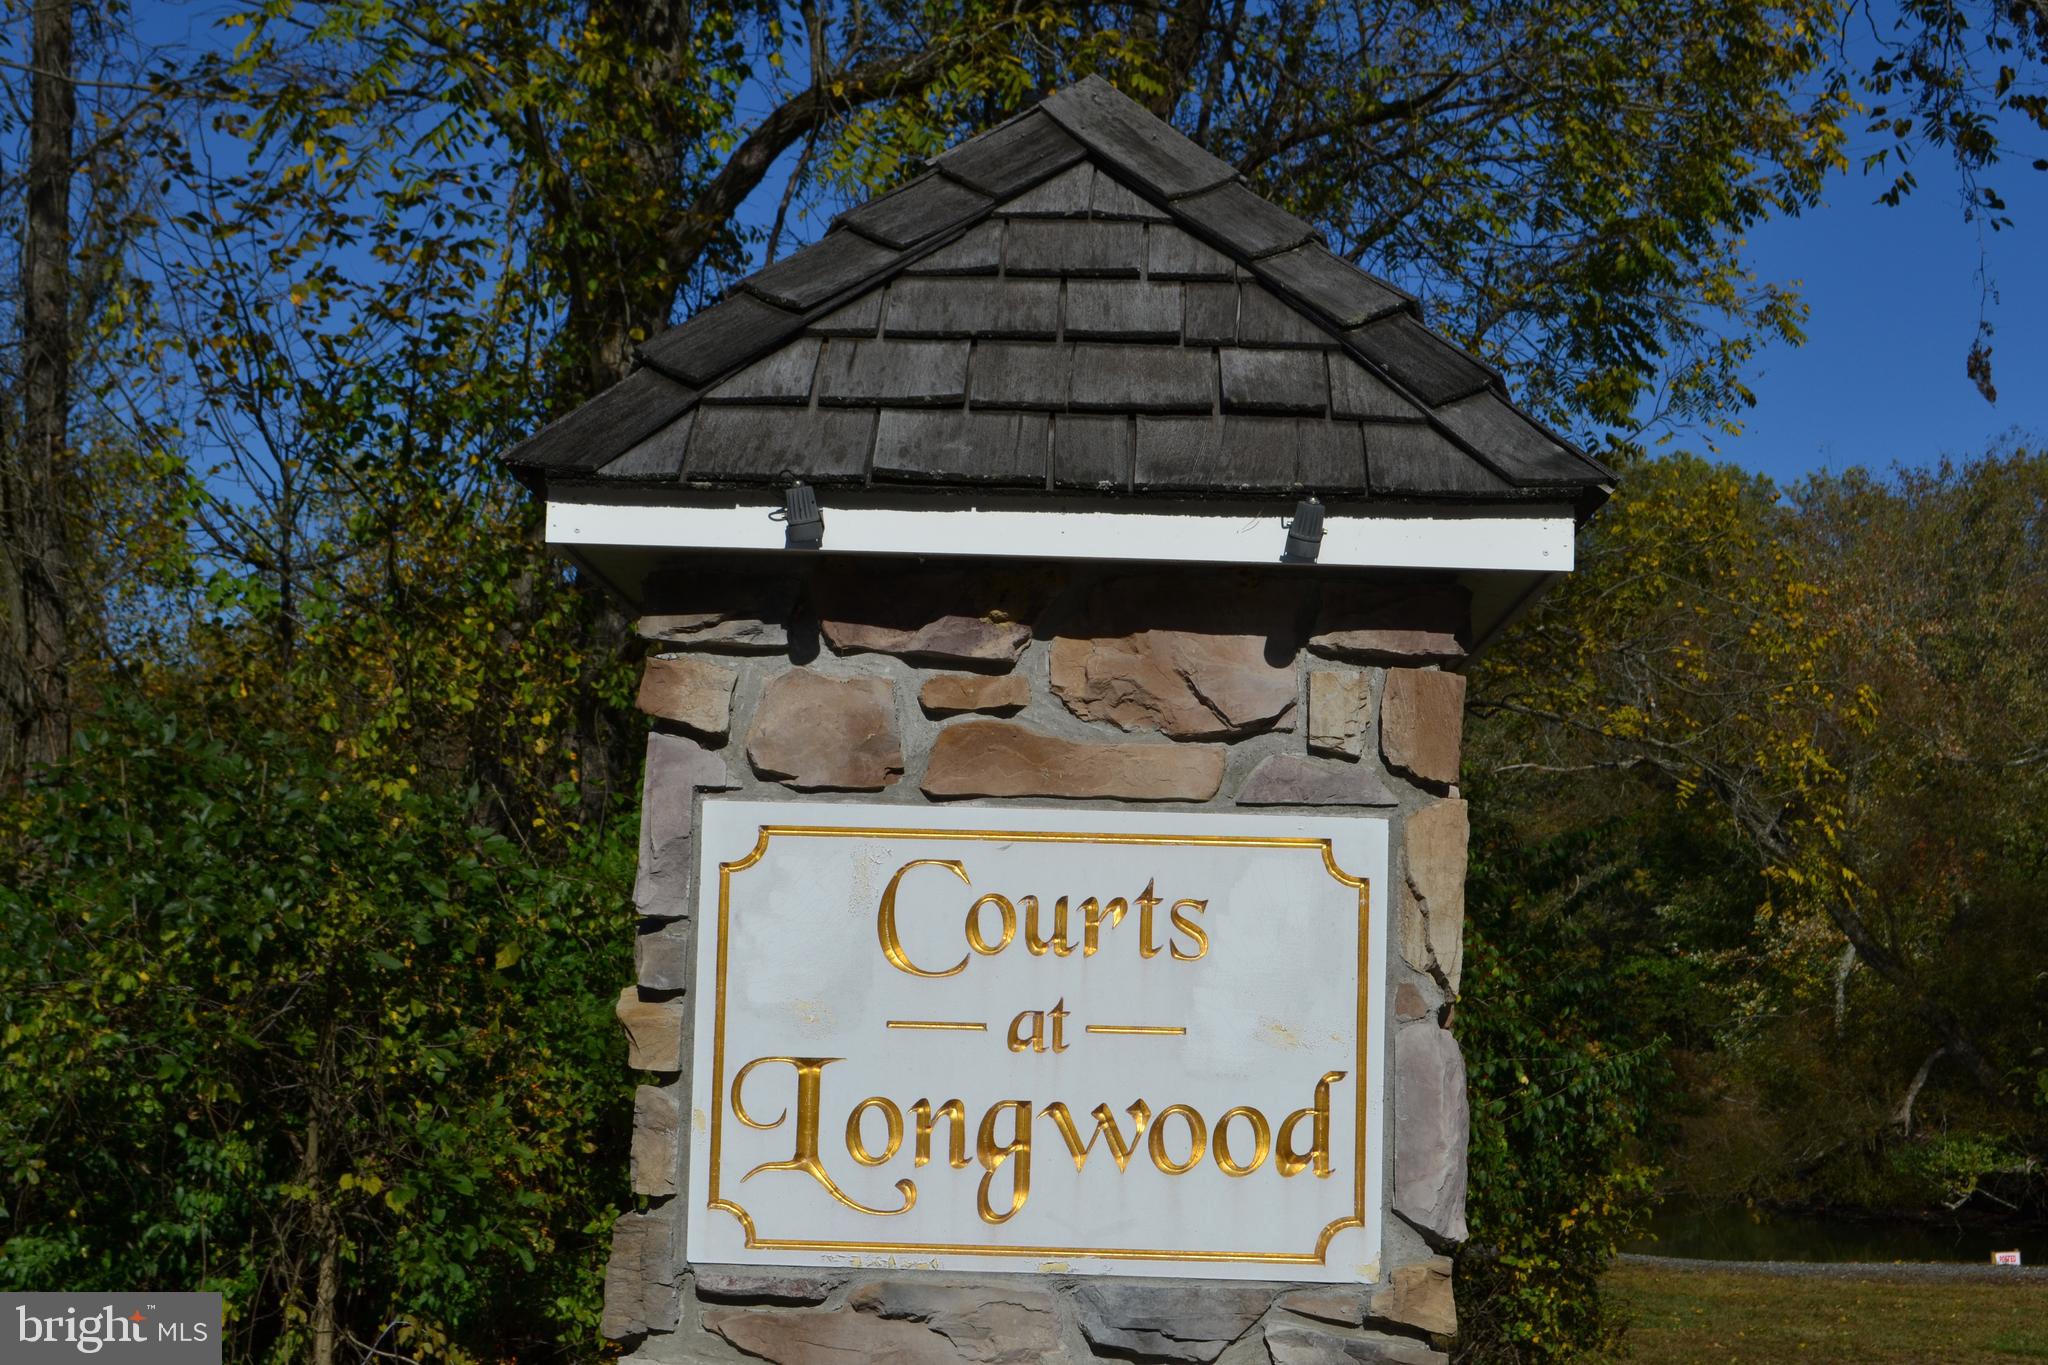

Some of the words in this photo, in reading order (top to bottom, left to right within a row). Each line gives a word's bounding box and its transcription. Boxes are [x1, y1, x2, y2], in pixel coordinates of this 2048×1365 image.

[877, 859, 1210, 978] Courts
[1006, 996, 1071, 1054] at
[731, 1056, 1349, 1225] Longwood
